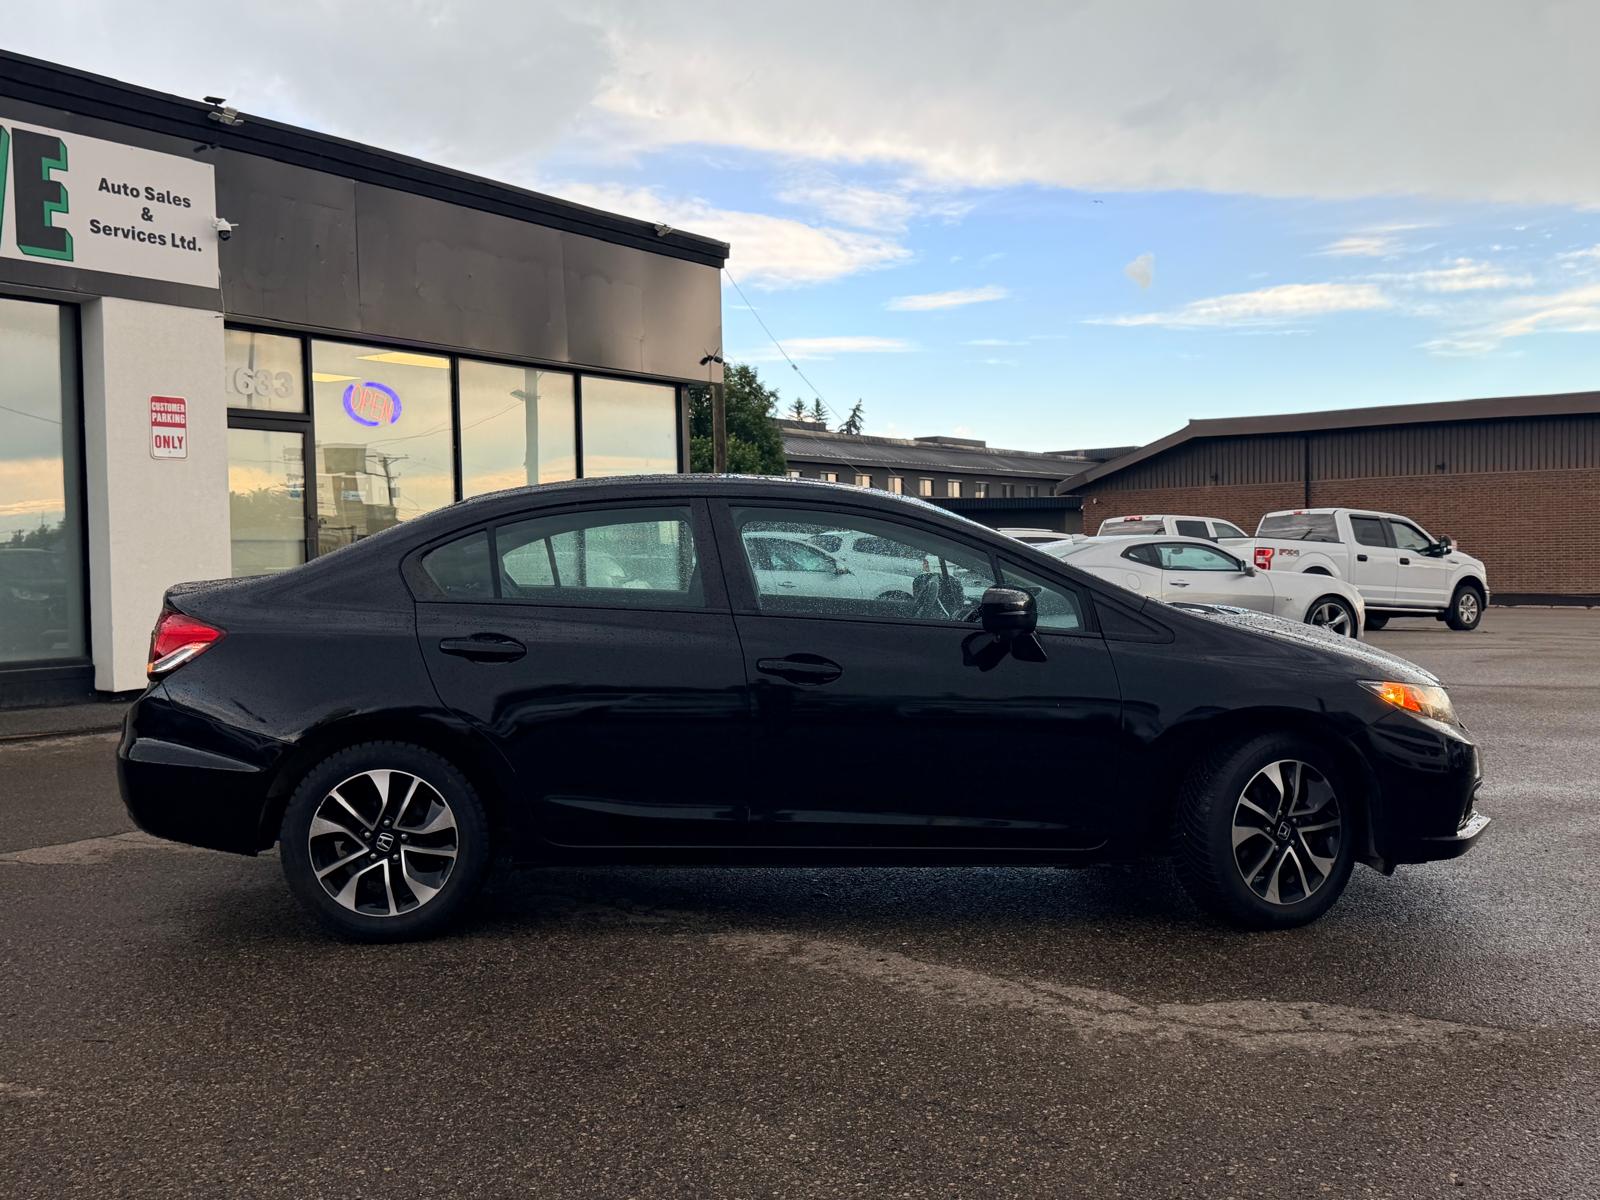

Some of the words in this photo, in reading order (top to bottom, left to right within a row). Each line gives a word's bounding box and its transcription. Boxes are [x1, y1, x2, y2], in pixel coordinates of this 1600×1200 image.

[0, 125, 74, 262] E
[98, 177, 140, 198] Auto
[144, 186, 192, 208] Sales
[140, 207, 154, 222] &
[89, 219, 167, 246] Services
[171, 233, 202, 252] Ltd.
[151, 402, 185, 412] CUSTOMER
[351, 384, 393, 424] OPEN
[151, 412, 185, 424] PARKING
[154, 434, 184, 449] ONLY
